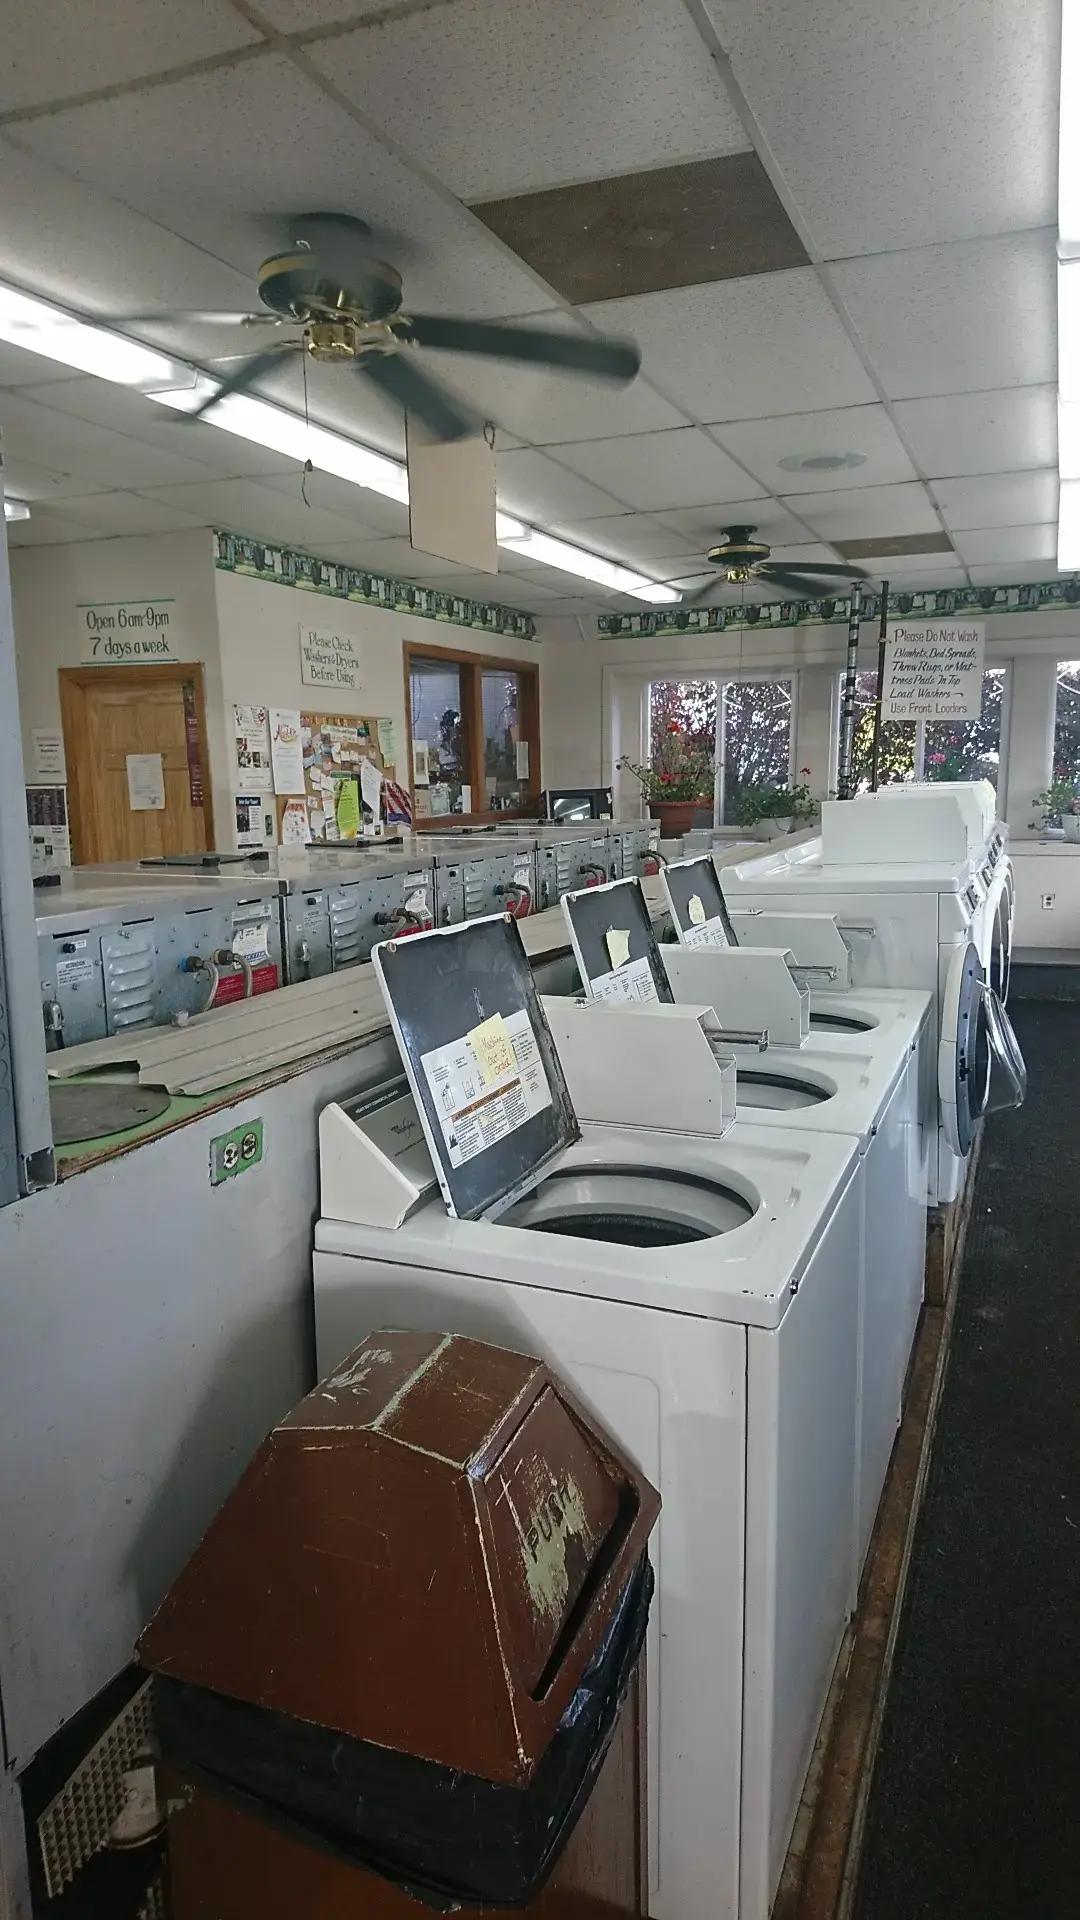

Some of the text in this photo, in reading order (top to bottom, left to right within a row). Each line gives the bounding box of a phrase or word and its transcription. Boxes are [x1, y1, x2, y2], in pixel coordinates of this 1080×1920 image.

[86, 610, 115, 632] Open
[309, 632, 353, 652] Please Check
[894, 629, 978, 642] Please Do Not Wash
[89, 634, 170, 658] 7 days a week
[893, 648, 976, 660] Blankets, Bed Spreads,
[335, 652, 359, 670] Dryers
[892, 661, 918, 672] Throw
[918, 661, 942, 674] Rugs,
[953, 662, 976, 672] Mat-
[310, 666, 355, 688] Before Using
[890, 675, 960, 688] tress Pads In Top
[889, 689, 950, 698] Load Washers
[890, 703, 968, 714] Use Front Loaders
[481, 1033, 505, 1053] Machine
[525, 1483, 573, 1564] PUSH
